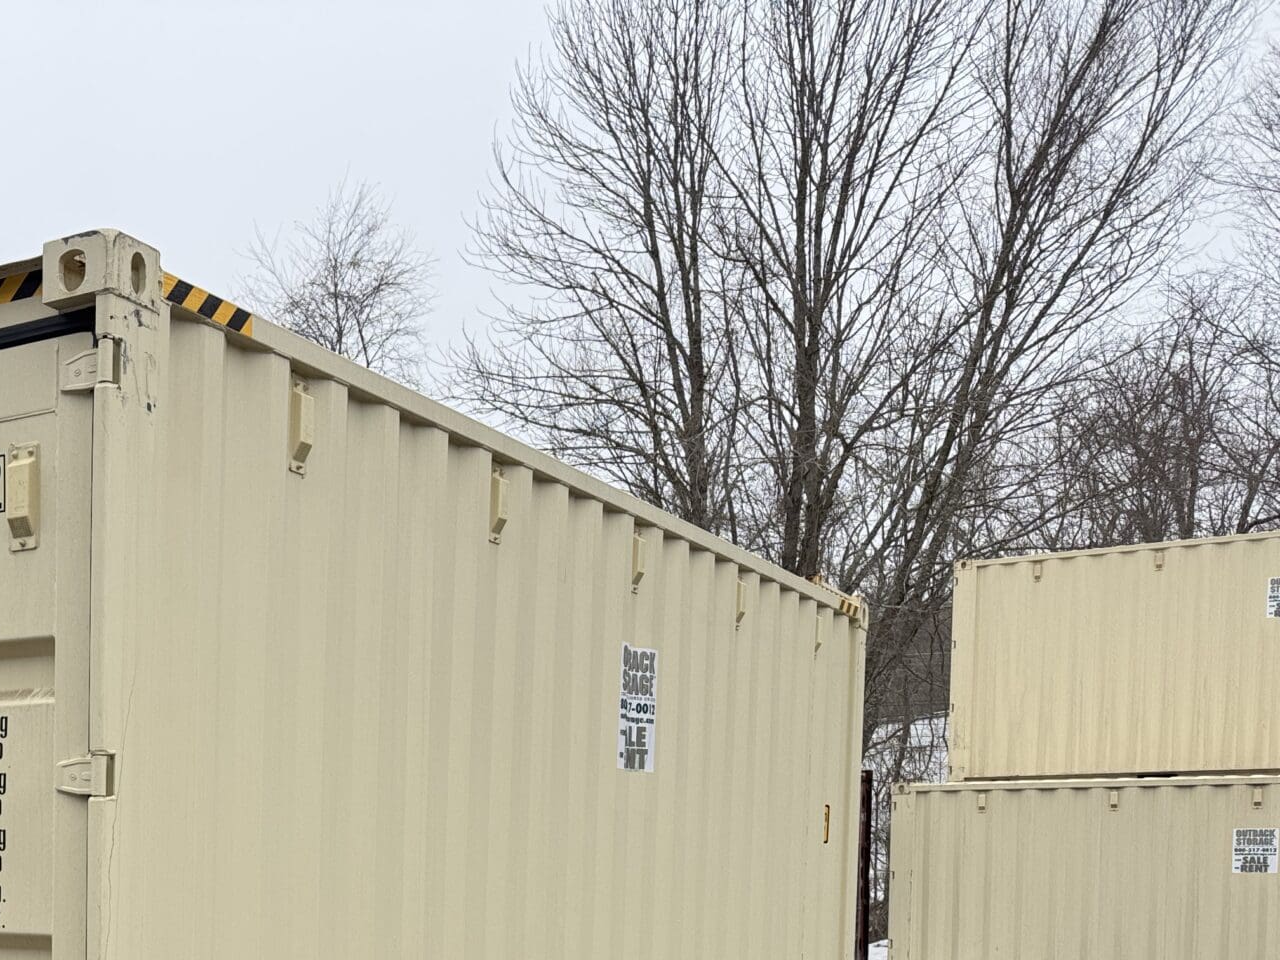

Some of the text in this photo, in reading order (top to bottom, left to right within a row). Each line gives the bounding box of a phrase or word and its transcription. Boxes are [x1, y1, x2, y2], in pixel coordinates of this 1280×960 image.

[1236, 829, 1276, 837] OUTBACK
[1236, 837, 1274, 846] STORAGE
[1242, 856, 1268, 864] SALE
[1240, 864, 1269, 873] RENT
